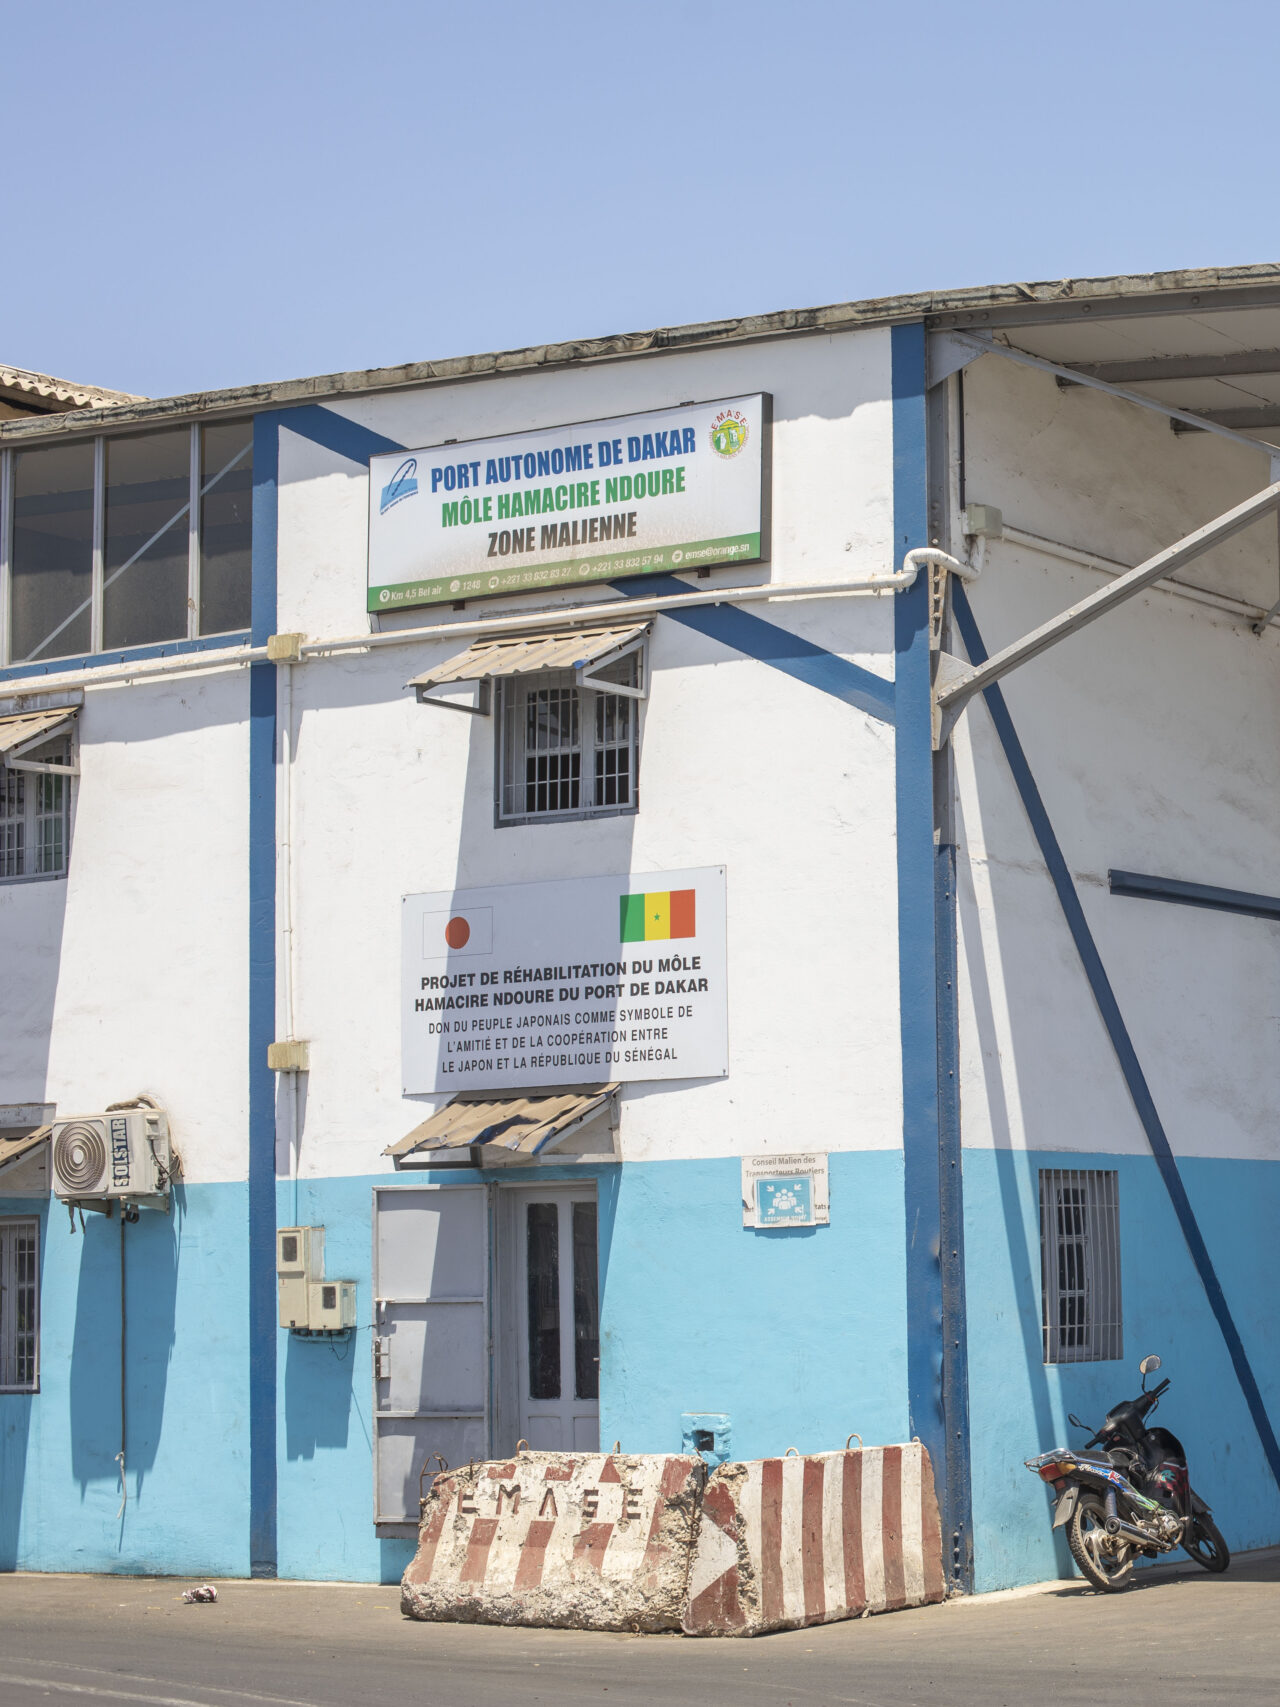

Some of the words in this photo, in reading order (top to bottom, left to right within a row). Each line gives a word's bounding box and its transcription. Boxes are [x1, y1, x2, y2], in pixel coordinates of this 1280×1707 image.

[431, 465, 480, 493] PORT
[485, 444, 594, 485] AUTONOME
[598, 440, 622, 467] DE
[628, 427, 696, 463] DAKAR
[442, 495, 492, 528] MÔLE
[497, 480, 600, 520] HAMACIRE
[605, 466, 686, 503] NDOURE
[487, 528, 535, 558] ZONE
[540, 511, 637, 551] MALIENNE
[501, 573, 520, 585] +221
[592, 561, 611, 573] +221
[614, 559, 624, 570] 33
[626, 557, 640, 569] 832
[391, 590, 403, 601] Km
[405, 588, 417, 600] 4,5
[418, 587, 430, 598] Bel
[431, 586, 442, 597] air
[421, 972, 476, 991] PROJET
[480, 970, 499, 986] DE
[503, 961, 627, 985] RÉHABILITATION
[632, 958, 653, 975] DU
[658, 954, 701, 973] MÔLE
[415, 993, 489, 1012] HAMACIRE
[493, 989, 555, 1007] NDOURE
[559, 987, 580, 1002] DU
[584, 984, 624, 1000] PORT
[629, 981, 650, 997] DE
[655, 977, 709, 995] DAKAR
[428, 1020, 450, 1034] DON
[454, 1019, 469, 1033] DU
[472, 1016, 513, 1032] PEUPLE
[516, 1013, 571, 1029] JAPONAIS
[575, 1010, 616, 1025] COMME
[619, 1006, 674, 1022] SYMBOLE
[678, 1005, 693, 1018] DE
[447, 1035, 491, 1053] L'AMITIÉ
[495, 1037, 508, 1050] ET
[512, 1036, 526, 1049] DE
[530, 1035, 543, 1048] LA
[547, 1029, 627, 1047] COOPÉRATION
[631, 1027, 668, 1041] ENTRE
[442, 1060, 455, 1073] LE
[458, 1058, 493, 1072] JAPON
[497, 1057, 510, 1070] ET
[513, 1056, 527, 1069] LA
[530, 1050, 601, 1068] RÉPUBLIQUE
[605, 1050, 620, 1063] DU
[624, 1046, 678, 1062] SÉNÉGAL
[111, 1118, 130, 1187] SOLSTAR
[752, 1158, 777, 1166] Conseil
[778, 1156, 802, 1165] Malien
